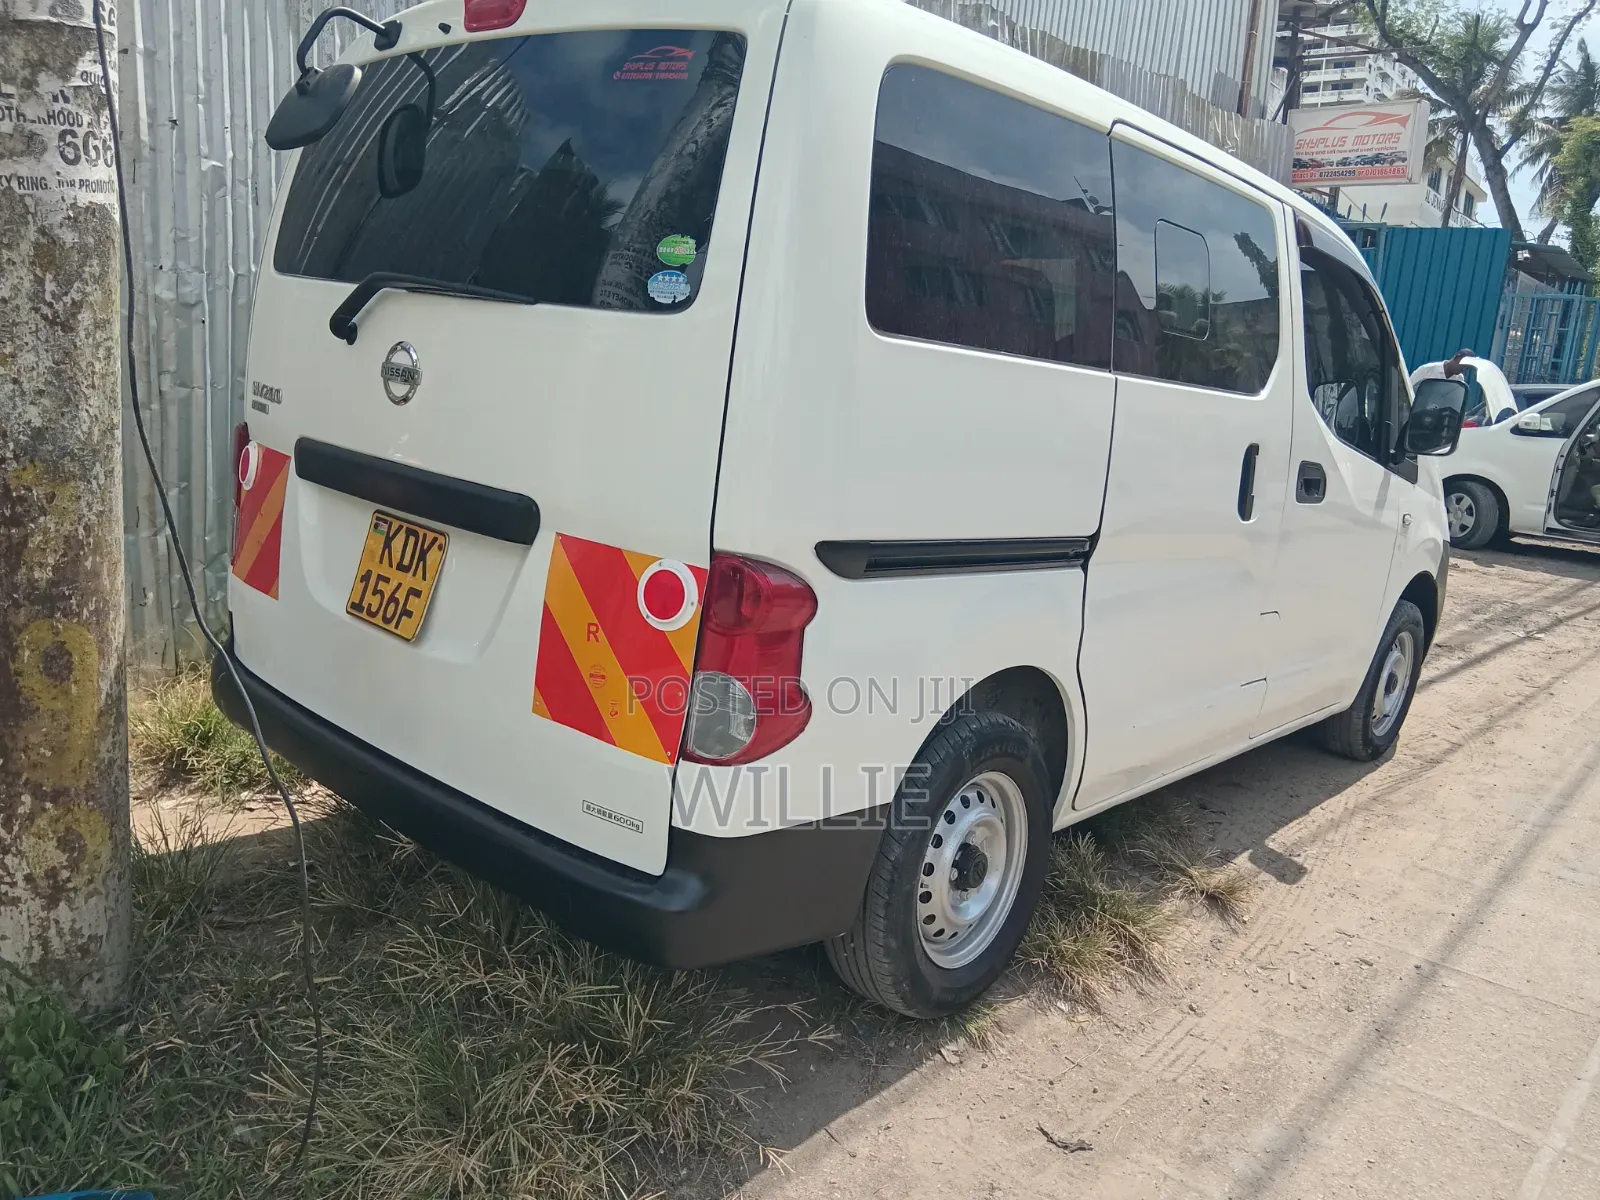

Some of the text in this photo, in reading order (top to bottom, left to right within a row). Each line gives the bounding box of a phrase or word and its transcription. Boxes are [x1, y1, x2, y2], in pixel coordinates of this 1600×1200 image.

[1352, 132, 1402, 146] MOTORS
[381, 365, 415, 381] NISSAN
[379, 521, 439, 582] KDK
[350, 569, 423, 630] 156F
[586, 622, 600, 643] R
